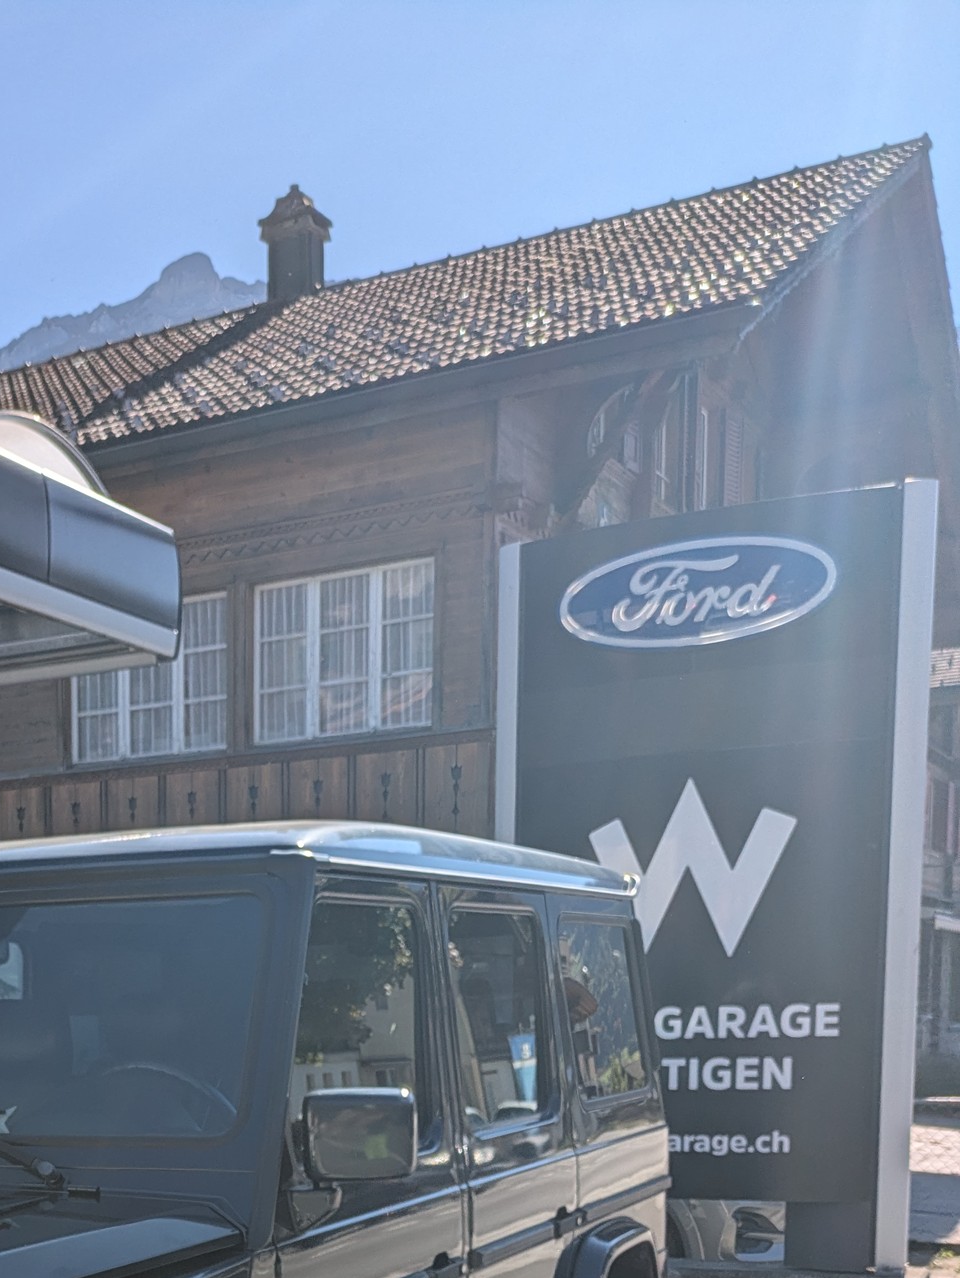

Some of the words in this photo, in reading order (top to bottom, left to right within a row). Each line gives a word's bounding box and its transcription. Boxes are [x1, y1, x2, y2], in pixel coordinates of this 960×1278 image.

[611, 553, 781, 633] Ford
[588, 777, 798, 957] W
[653, 1003, 841, 1041] GARAGE
[661, 1056, 794, 1091] TIGEN
